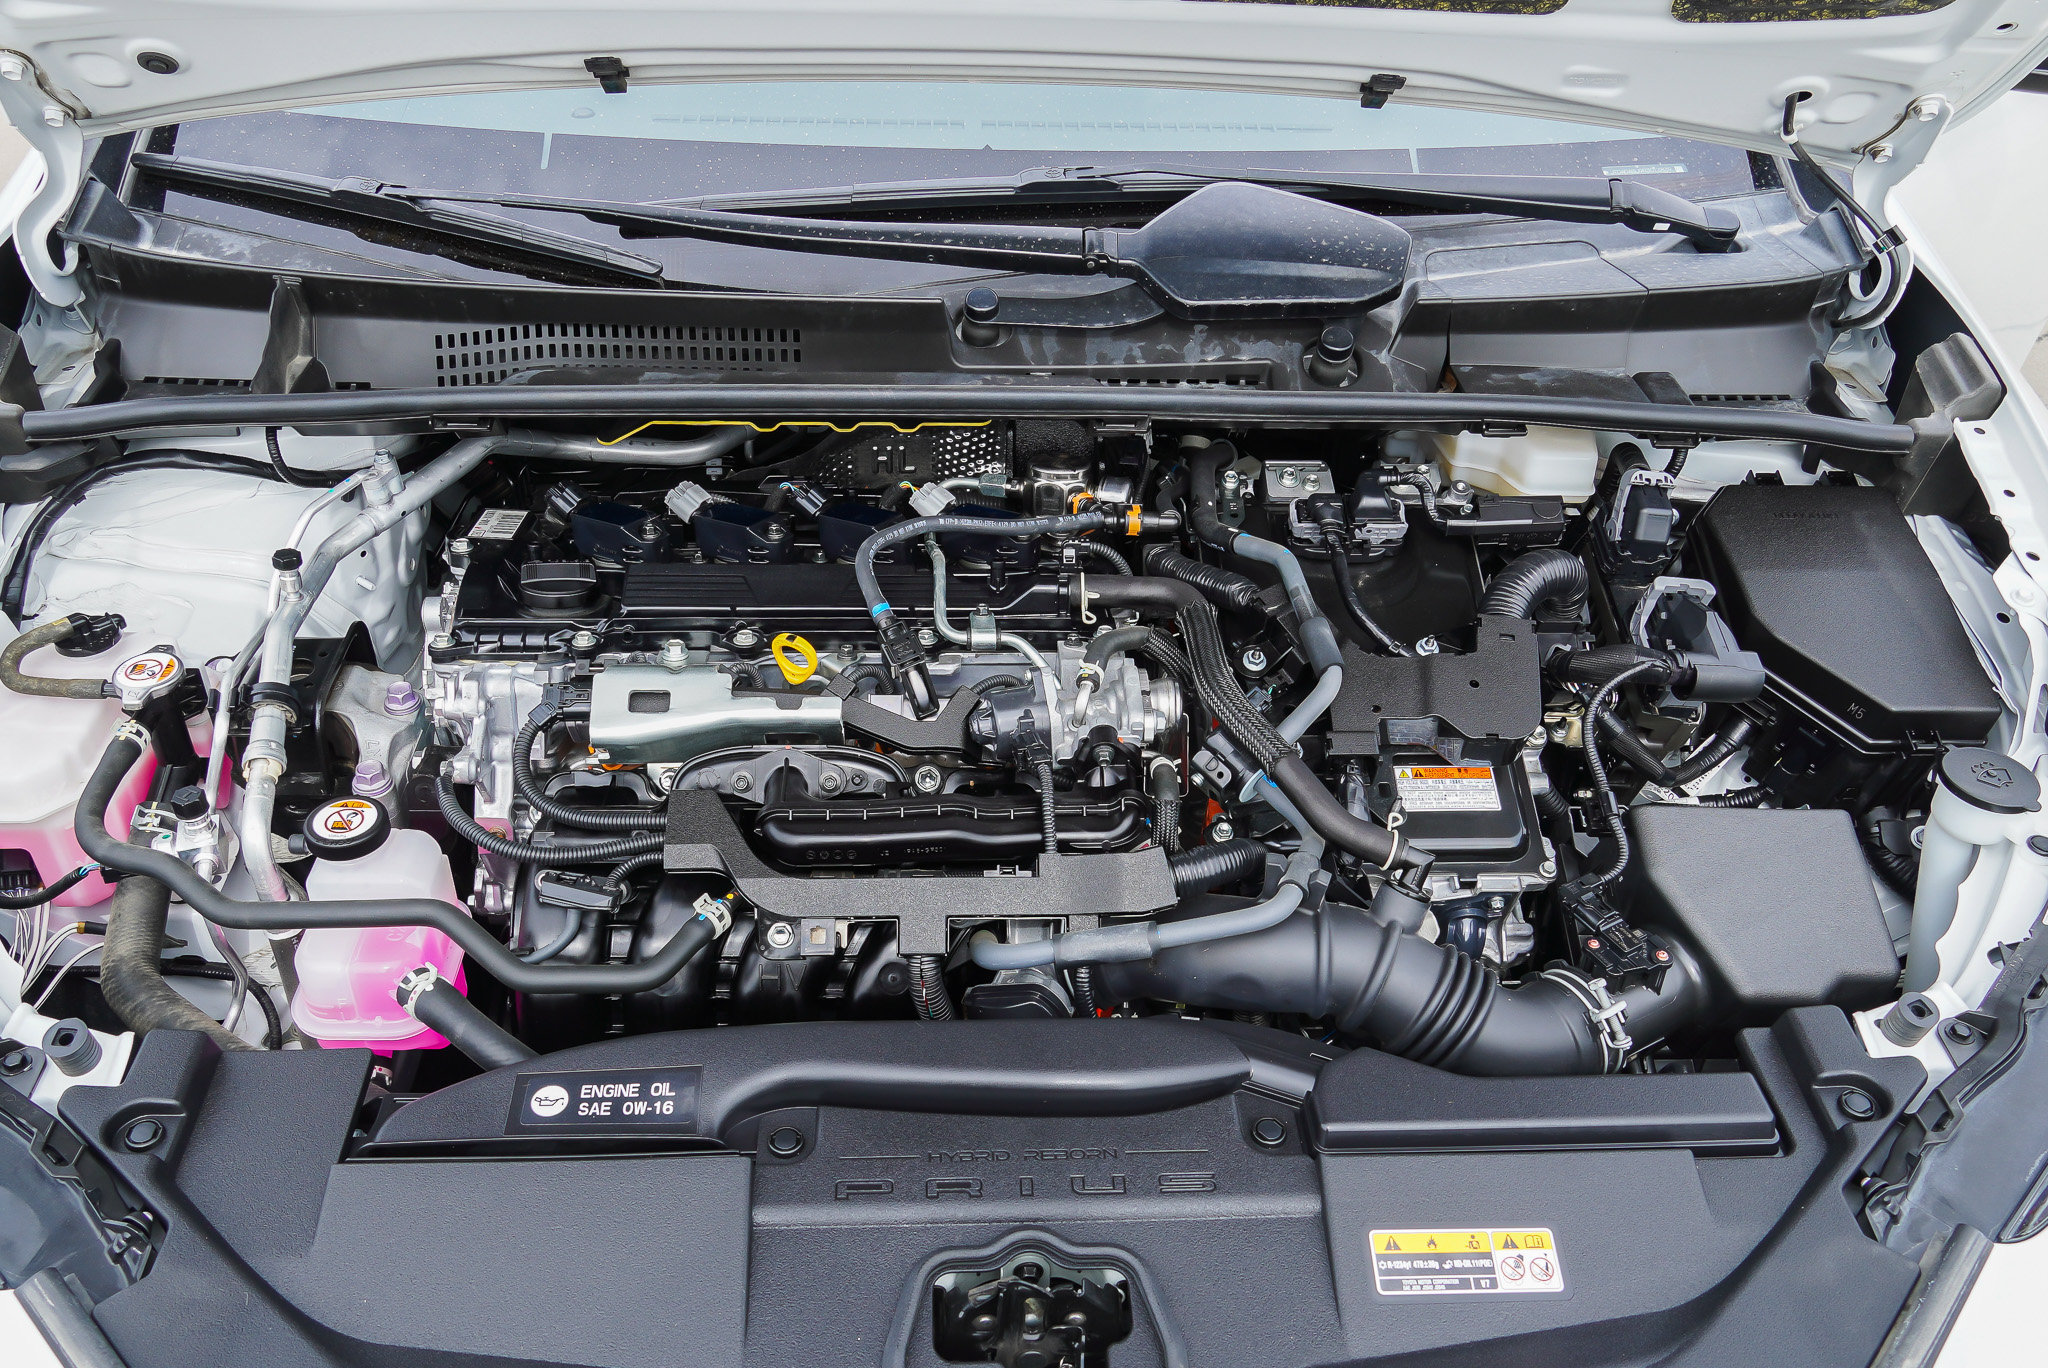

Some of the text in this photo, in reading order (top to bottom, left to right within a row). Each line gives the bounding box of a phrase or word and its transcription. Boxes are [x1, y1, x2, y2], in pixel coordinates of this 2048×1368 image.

[1847, 702, 1866, 719] M5
[759, 964, 807, 991] HV
[580, 1083, 676, 1098] ENGINE OIL
[577, 1101, 674, 1116] SAE 0W-16
[928, 1148, 1118, 1162] HYBRID REBORN
[835, 1171, 1217, 1200] PRIUS
